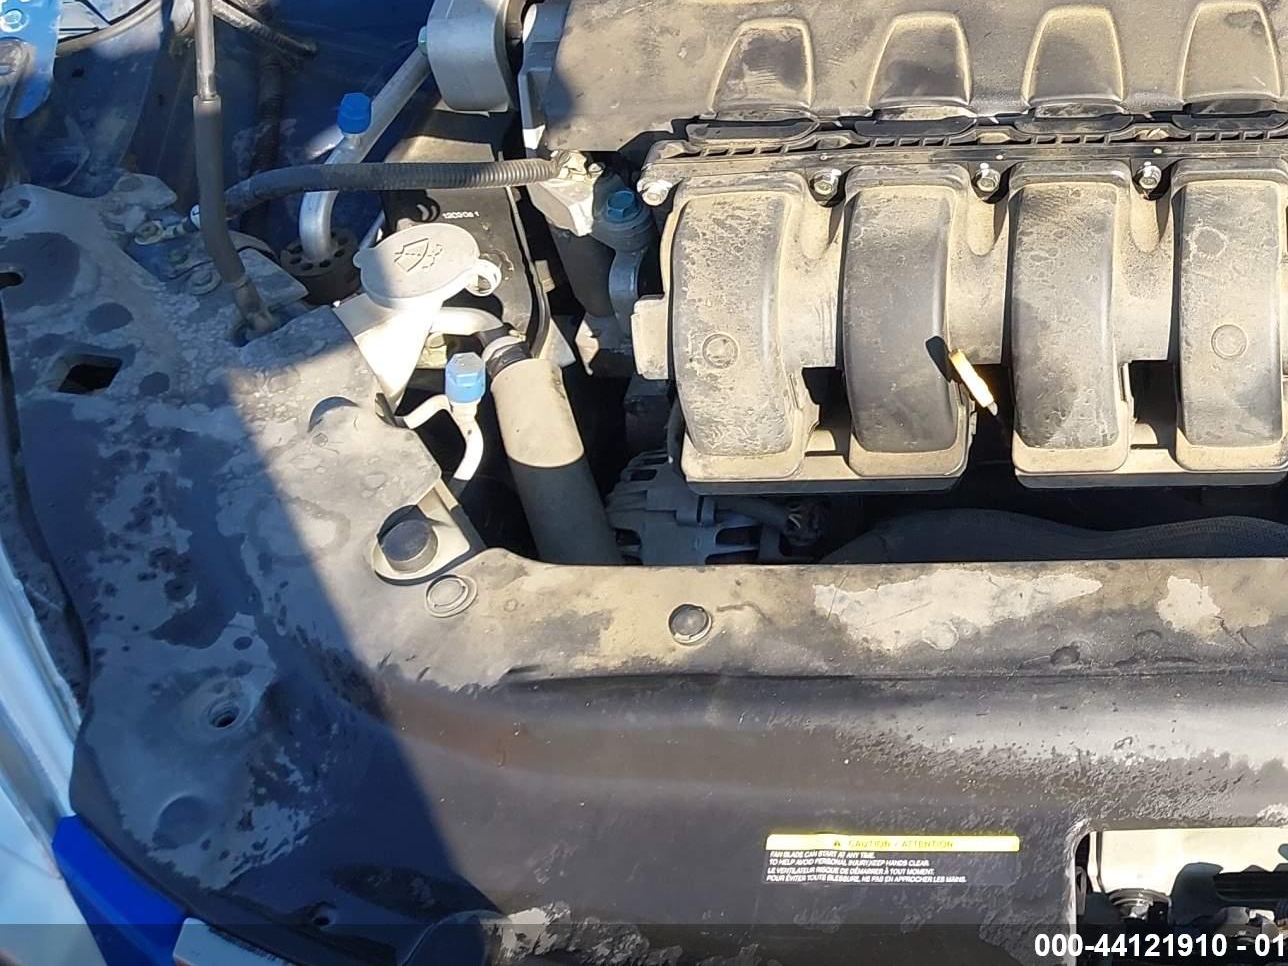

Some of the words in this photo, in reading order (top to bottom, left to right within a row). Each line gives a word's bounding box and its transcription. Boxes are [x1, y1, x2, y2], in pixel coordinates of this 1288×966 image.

[848, 840, 890, 848] CAUTION
[902, 840, 953, 848] ATTENTION
[770, 851, 783, 859] FAN
[783, 851, 804, 859] BLADE
[804, 850, 818, 859] CAN
[818, 850, 837, 859] START
[837, 851, 845, 859] AT
[846, 851, 860, 859] ANY
[769, 858, 779, 866] TO
[779, 858, 795, 866] HELP
[795, 858, 814, 866] AVOID
[814, 858, 847, 866] PERSONAL
[885, 859, 908, 867] HANDS
[767, 866, 777, 874] LE
[777, 866, 816, 874] VENTILATEUR
[816, 866, 840, 874] RISQUE
[840, 867, 849, 875] DE
[766, 874, 785, 882] POUR
[786, 872, 807, 882] ÉVITER
[807, 874, 826, 882] TOUTE
[862, 875, 871, 883] NE
[871, 875, 884, 883] PAS
[884, 875, 894, 883] EN
[894, 875, 933, 883] APPROCHER
[933, 875, 945, 883] LES
